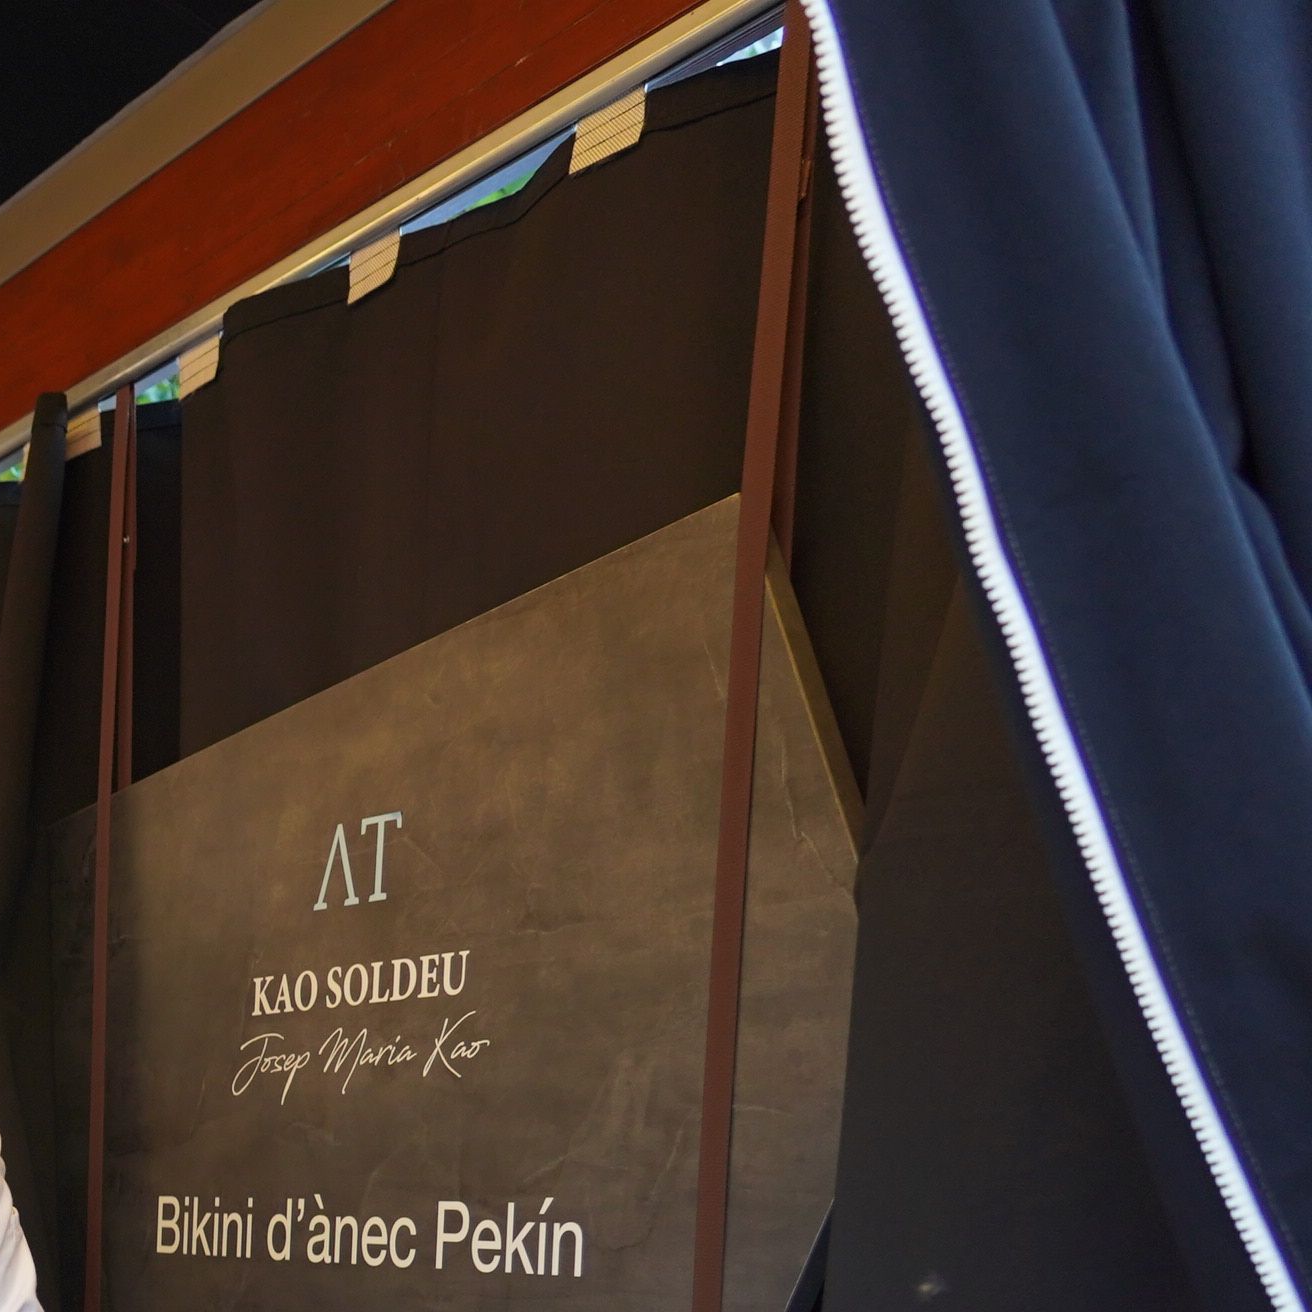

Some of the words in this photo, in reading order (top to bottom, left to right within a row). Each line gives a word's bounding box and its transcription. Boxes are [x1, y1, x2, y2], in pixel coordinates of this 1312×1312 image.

[251, 971, 319, 1016] KAO
[325, 950, 470, 1009] SOLDEU
[231, 1032, 311, 1106] Josep
[422, 1010, 490, 1078] Kao
[156, 1195, 254, 1259] Bikini
[435, 1196, 584, 1278] Pekín
